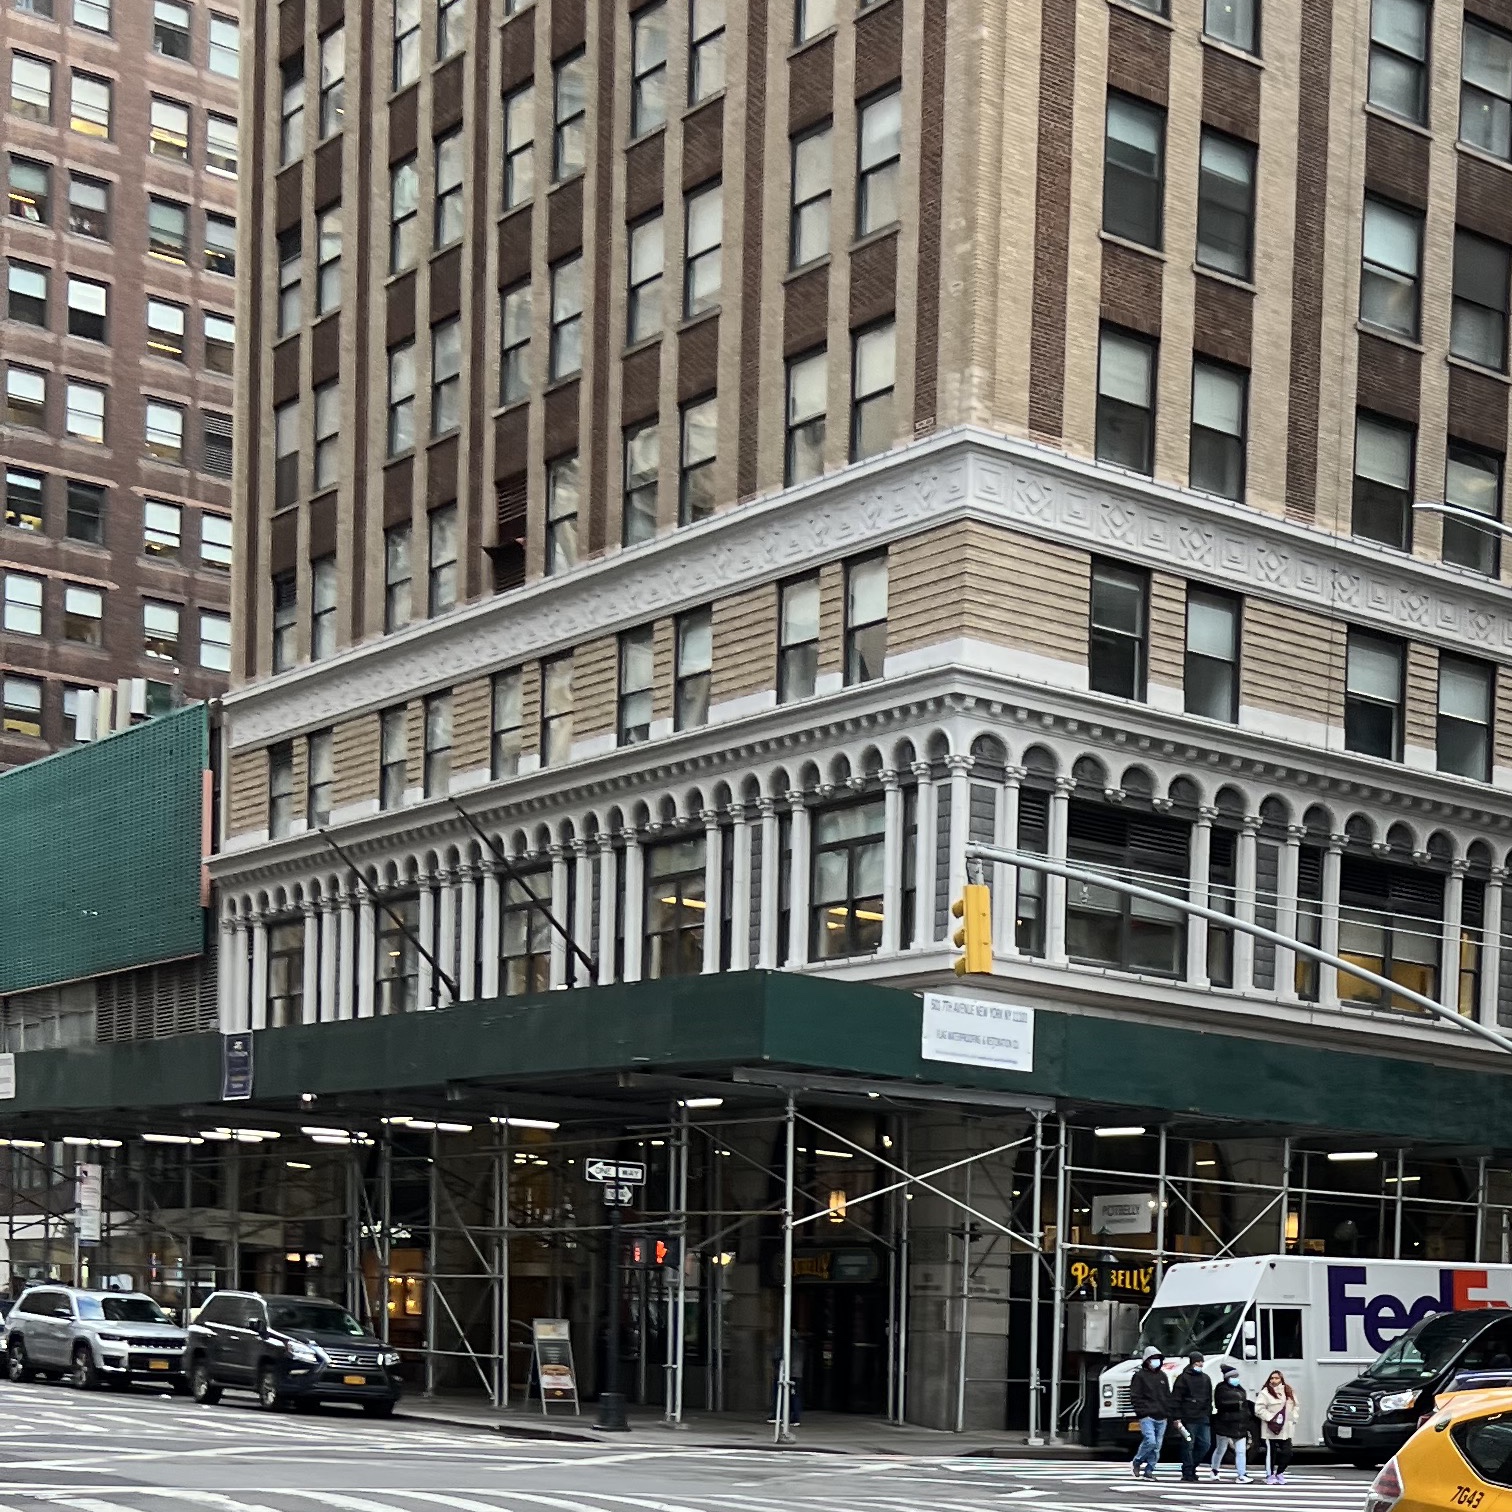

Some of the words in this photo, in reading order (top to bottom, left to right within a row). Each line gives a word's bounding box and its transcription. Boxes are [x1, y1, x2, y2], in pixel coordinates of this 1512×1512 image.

[953, 1002, 975, 1015] AVENUE
[976, 1005, 988, 1017] NEW
[989, 1008, 1002, 1019] YORK
[595, 1166, 612, 1175] ONE
[1071, 1262, 1155, 1293] POBELLY
[1450, 1485, 1485, 1509] 7G43
